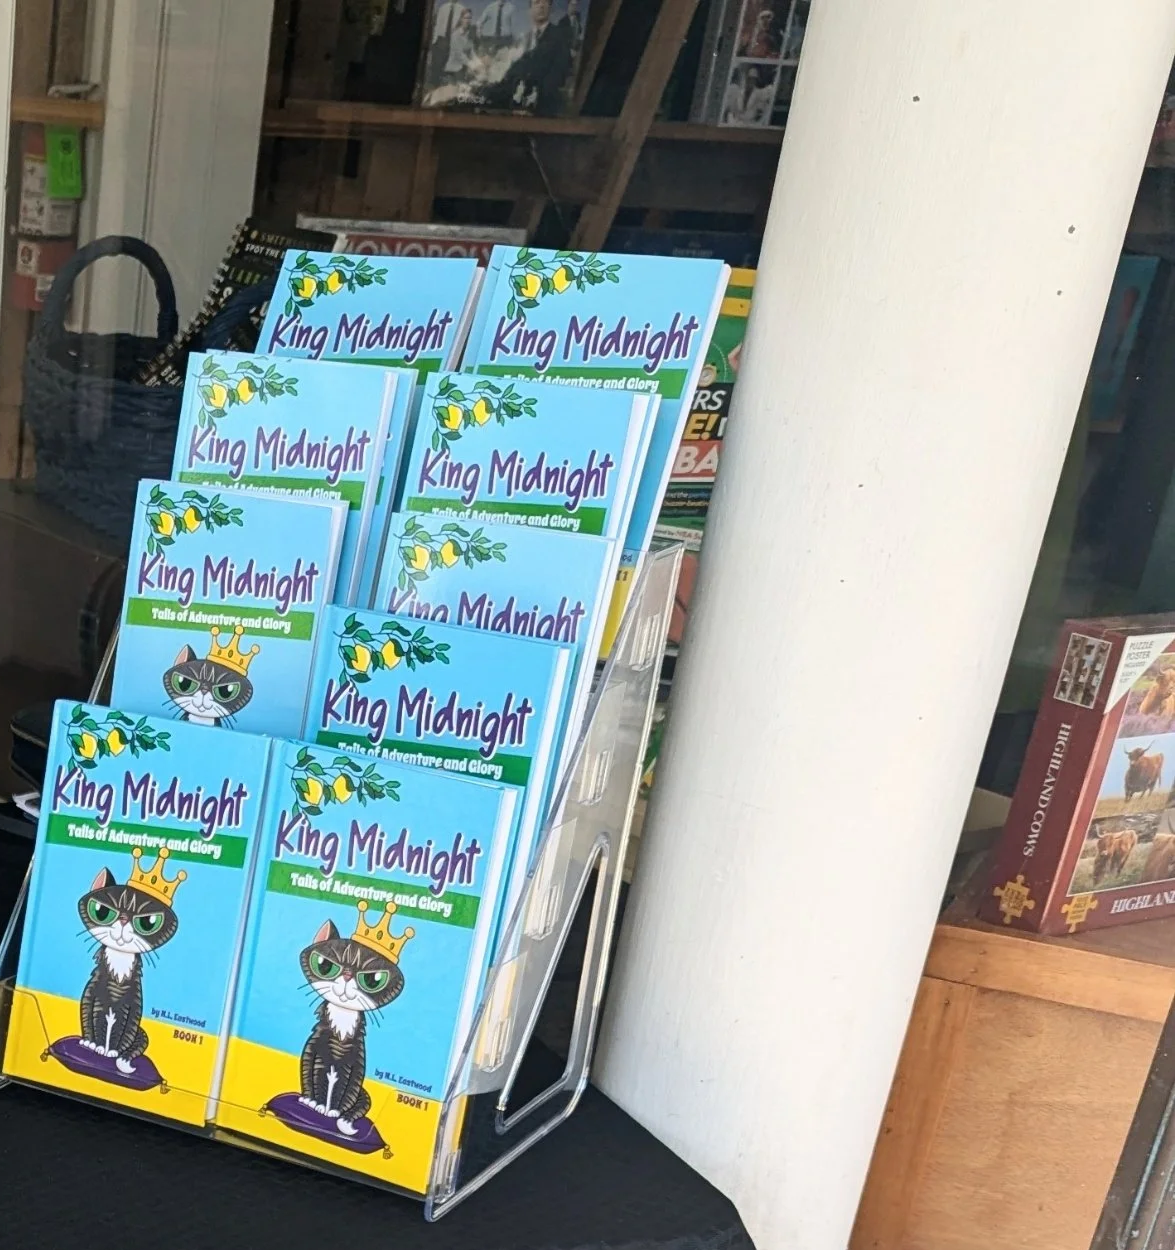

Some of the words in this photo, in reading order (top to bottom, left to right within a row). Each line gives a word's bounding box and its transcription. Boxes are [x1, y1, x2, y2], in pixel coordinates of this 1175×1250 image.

[245, 243, 264, 255] SPOT
[268, 313, 328, 361] King
[333, 309, 453, 364] Midnight
[489, 315, 557, 372] King
[563, 312, 699, 374] Midnight
[603, 378, 624, 389] and
[627, 379, 659, 392] Glory
[692, 389, 726, 410] RS
[188, 425, 246, 479] King
[254, 426, 370, 486] Midnight
[418, 448, 480, 505] King
[488, 449, 614, 512] Midnight
[459, 508, 471, 519] of
[472, 510, 527, 525] Adventure
[528, 514, 548, 527] and
[550, 516, 580, 531] Glory
[138, 552, 195, 607] King
[203, 555, 319, 615] Midnight
[152, 608, 176, 621] Tails
[177, 610, 189, 622] of
[189, 612, 241, 625] Adventure
[242, 616, 261, 628] and
[263, 618, 291, 633] Glory
[457, 591, 585, 643] Midnight
[1127, 651, 1151, 660] POSTER
[1129, 640, 1154, 650] PUZZLE
[322, 679, 387, 744] King
[396, 685, 533, 759] Midnight
[368, 744, 381, 758] of
[382, 748, 442, 768] Adventure
[444, 756, 466, 772] and
[468, 758, 503, 780] Glory
[1038, 722, 1072, 809] HIGHLAND
[53, 765, 114, 827] King
[122, 771, 249, 840] Midnight
[68, 824, 94, 840] Tails
[95, 827, 108, 841] of
[109, 829, 166, 849] Adventure
[167, 838, 188, 851] and
[190, 840, 222, 859] Glory
[1023, 810, 1046, 857] COWS
[275, 810, 339, 876] King
[347, 820, 481, 897] Midnight
[290, 872, 318, 890] Tails
[319, 878, 332, 893] of
[333, 881, 393, 902] Adventure
[394, 893, 417, 908] and
[418, 896, 452, 917] Glory
[151, 1008, 160, 1018] by
[174, 1013, 207, 1028] Eastwood
[173, 1029, 198, 1044] BOOK
[199, 1036, 204, 1045] 1
[375, 1068, 384, 1080] by
[398, 1076, 432, 1093] Eastwood
[396, 1093, 423, 1110] BOOK
[424, 1102, 429, 1111] 1
